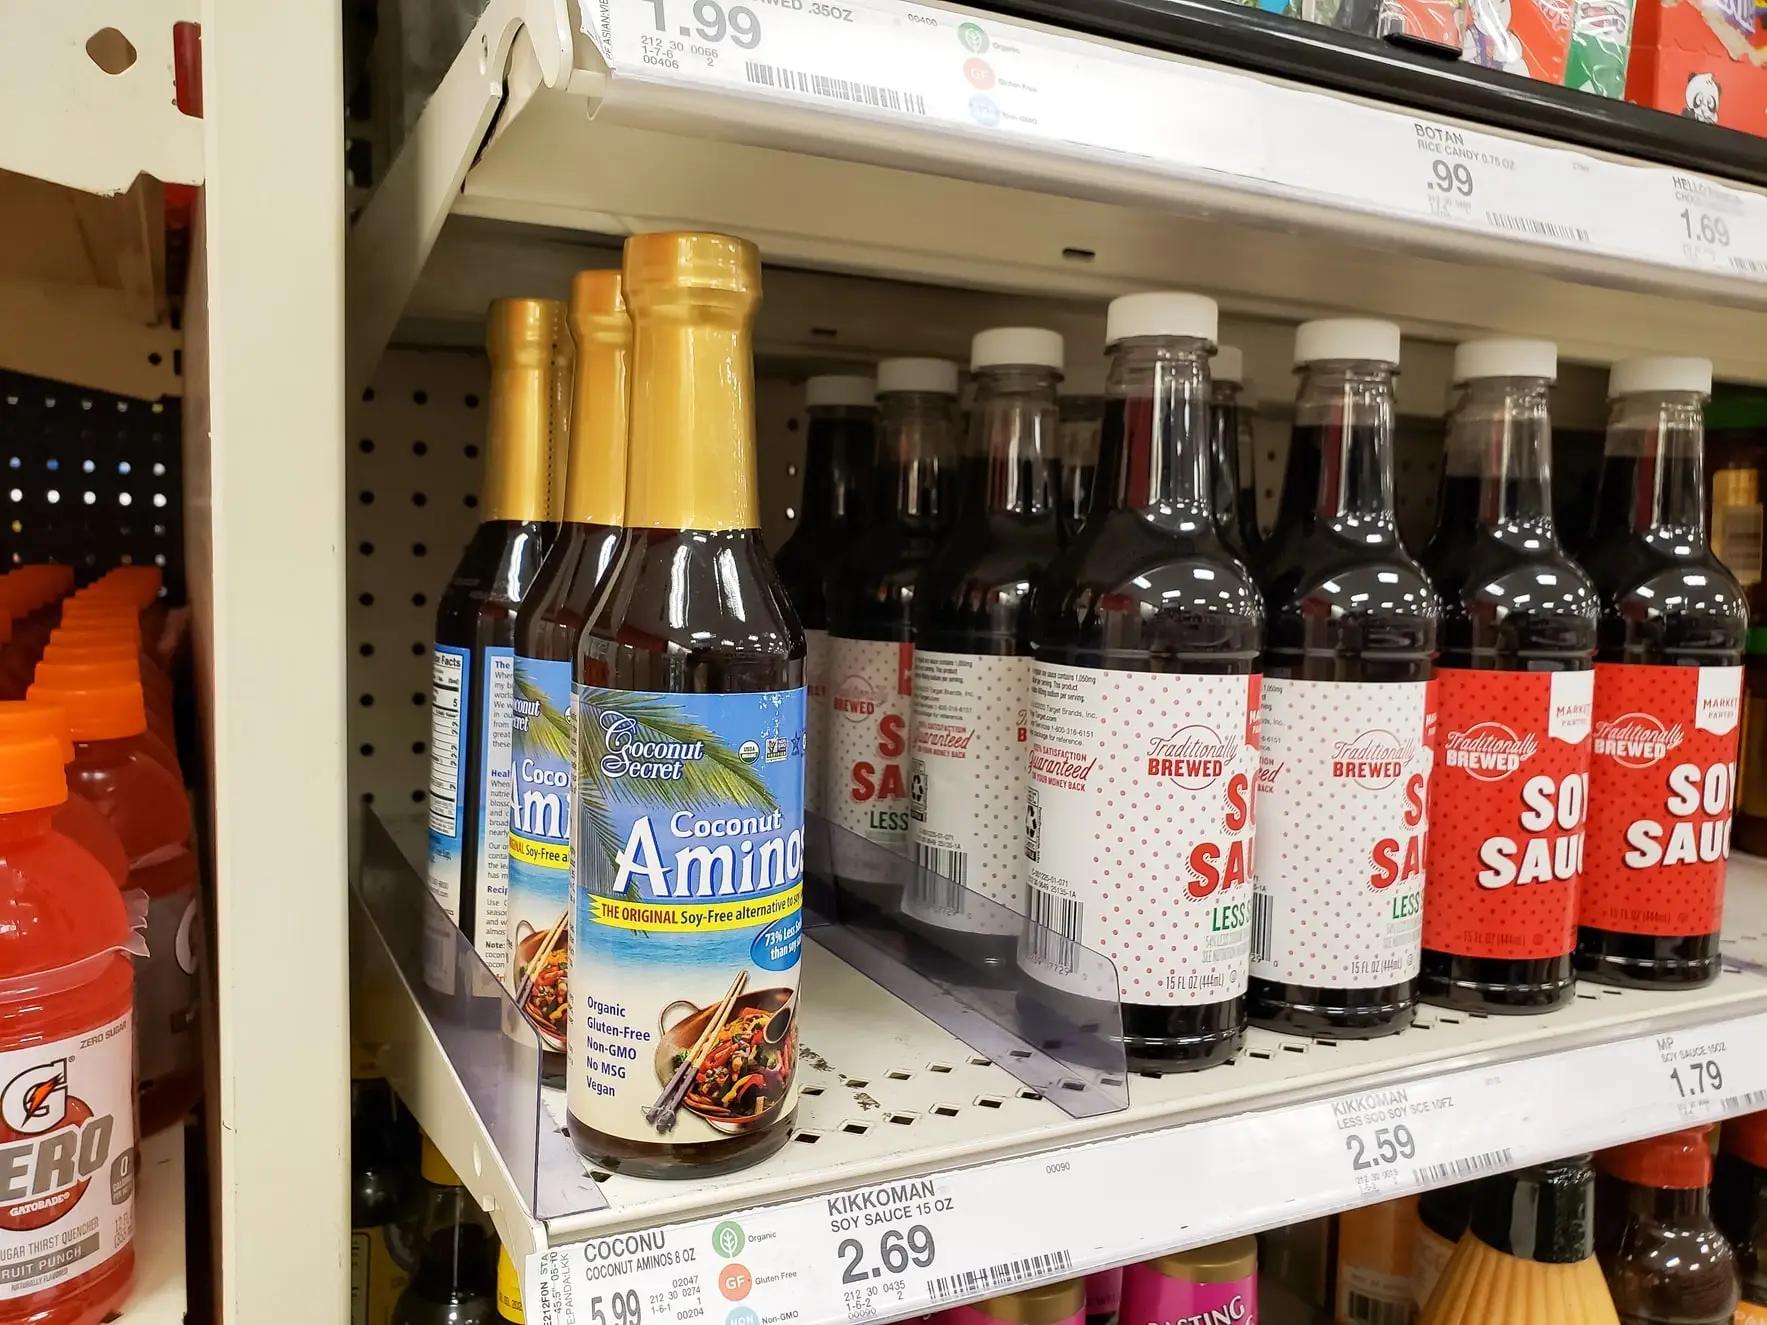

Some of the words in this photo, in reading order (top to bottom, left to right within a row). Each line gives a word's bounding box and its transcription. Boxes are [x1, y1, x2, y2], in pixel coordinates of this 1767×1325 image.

[643, 0, 761, 49] 1.99
[641, 35, 663, 48] 212
[670, 40, 684, 52] 30
[691, 46, 719, 58] 0066
[643, 45, 674, 59] 1-7-6
[707, 58, 714, 66] 2
[643, 55, 679, 69] 00406
[1414, 123, 1464, 146] BOTAN
[1417, 139, 1441, 154] RICE
[1444, 146, 1479, 161] CANDY
[1427, 159, 1473, 196] .99
[1680, 208, 1730, 247] 1.69
[441, 655, 461, 668] Facts
[496, 661, 510, 669] The
[600, 711, 703, 760] Coconut
[1446, 730, 1538, 761] Traditionally
[1594, 721, 1684, 750] Traditionally
[1147, 735, 1238, 767] Traditionally
[1331, 738, 1415, 767] Traditionally
[1594, 739, 1666, 759] BREWED
[601, 753, 683, 780] Secret
[1148, 758, 1222, 777] BREWED
[1333, 762, 1401, 778] BREWED
[1447, 751, 1519, 771] BREWED
[522, 759, 570, 788] Coco
[1068, 781, 1085, 792] BACK
[670, 807, 782, 838] Coconut
[870, 810, 909, 831] LESS
[526, 844, 560, 862] Soy-Free
[1370, 836, 1428, 889] SA
[602, 903, 620, 920] THE
[622, 906, 678, 924] ORIGINAL
[680, 910, 733, 927] Soy-Free
[736, 899, 786, 920] alternative
[787, 897, 793, 907] to
[1393, 893, 1419, 920] LESS
[1212, 906, 1245, 932] LESS
[765, 931, 783, 947] 73%
[770, 945, 788, 961] than
[1351, 962, 1360, 973] 15
[1362, 961, 1369, 973] FL
[1371, 960, 1380, 972] OZ
[1166, 976, 1176, 990] 15
[1177, 976, 1185, 990] FL
[1188, 975, 1198, 989] OZ
[587, 996, 626, 1018] Organic
[80, 1034, 104, 1050] ZERO
[105, 1021, 127, 1040] SUGAR
[587, 1016, 651, 1042] Gluten-Free
[587, 1037, 637, 1060] Non-GMO
[1656, 1036, 1674, 1051] MP
[1680, 1045, 1707, 1060] SAUCE
[586, 1056, 599, 1072] No
[601, 1059, 626, 1080] MSG
[1670, 1060, 1723, 1098] 1.79
[586, 1076, 616, 1097] Vegan
[1331, 1089, 1408, 1117] KIKKOMAN
[1337, 1116, 1363, 1130] LESS
[1365, 1111, 1386, 1125] SOD
[1389, 1106, 1407, 1119] SOY
[1411, 1101, 1431, 1115] SCE
[0, 1114, 113, 1201] ERO
[1346, 1124, 1416, 1171] 2.59
[120, 1156, 129, 1177] 0
[1046, 1162, 1070, 1174] 00090
[10, 1195, 65, 1216] GATORADE
[827, 1180, 936, 1216] KIKKOMAN
[831, 1216, 860, 1233] SOY
[865, 1205, 912, 1228] SAUCE
[916, 1203, 931, 1217] 15
[934, 1198, 954, 1213] OZ
[0, 1246, 26, 1261] UGAR
[28, 1235, 60, 1255] THIRST
[61, 1217, 99, 1245] QUENCHER
[584, 1230, 666, 1263] COCONU
[748, 1231, 777, 1244] Organic
[2, 1263, 34, 1279] RUIT
[39, 1246, 82, 1271] PUNCH
[540, 1253, 549, 1275] STA
[586, 1260, 633, 1281] COCONUT
[636, 1252, 673, 1273] AMINOS
[675, 1251, 681, 1262] 8
[683, 1248, 696, 1261] OZ
[837, 1224, 935, 1285] 2.69
[672, 1275, 698, 1289] 02047
[726, 1275, 745, 1290] GF
[755, 1275, 780, 1285] Gluten
[781, 1271, 798, 1280] Free
[650, 1292, 664, 1304] 212
[668, 1290, 678, 1300] 30
[682, 1286, 700, 1297] 0274
[844, 1289, 862, 1302] 212
[866, 1285, 878, 1298] 30
[883, 1280, 906, 1293] 0435
[847, 1297, 872, 1311] 1-6-2
[898, 1291, 903, 1301] 2
[591, 1288, 642, 1325] 5.99
[651, 1303, 671, 1315] 1-6-1
[697, 1297, 702, 1305] 1
[677, 1307, 704, 1320] 00204
[848, 1307, 877, 1320] 00090
[761, 1310, 799, 1325] Non-GMO
